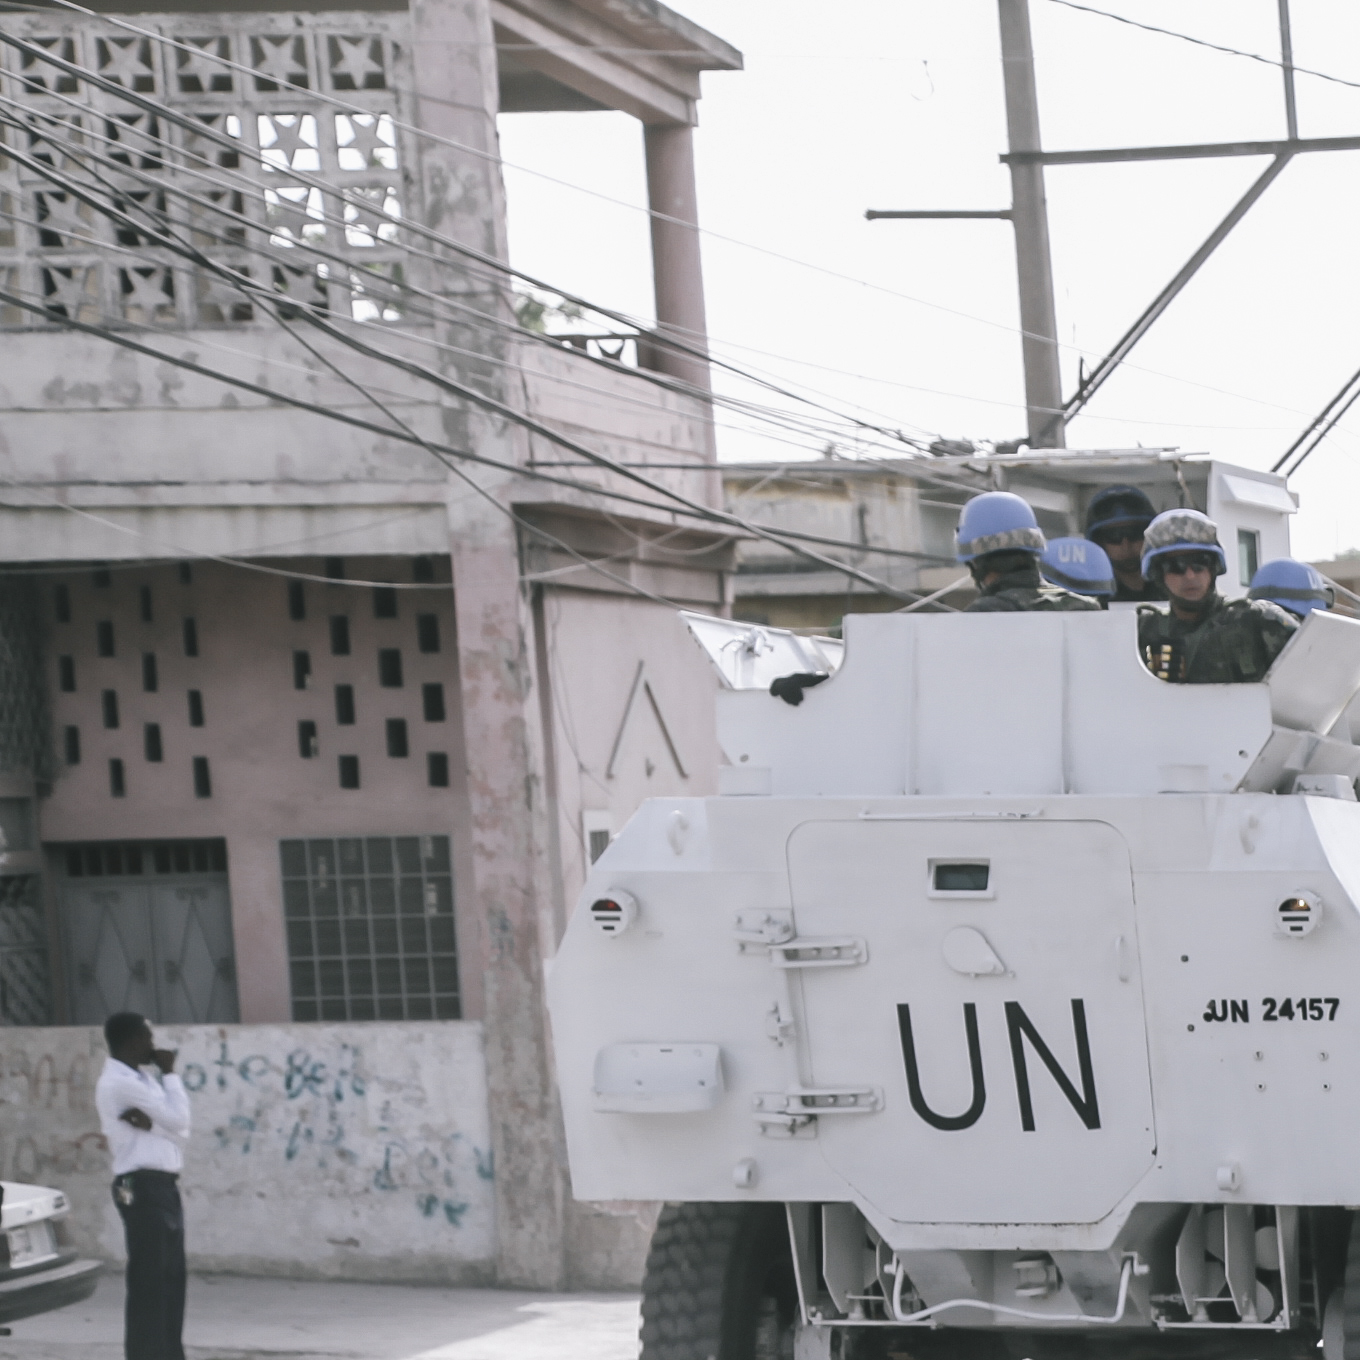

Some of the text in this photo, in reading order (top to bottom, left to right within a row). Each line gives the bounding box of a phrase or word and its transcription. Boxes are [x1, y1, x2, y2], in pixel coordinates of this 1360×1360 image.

[1058, 544, 1087, 564] UN
[1262, 998, 1339, 1021] 24157
[897, 998, 1101, 1131] UN
